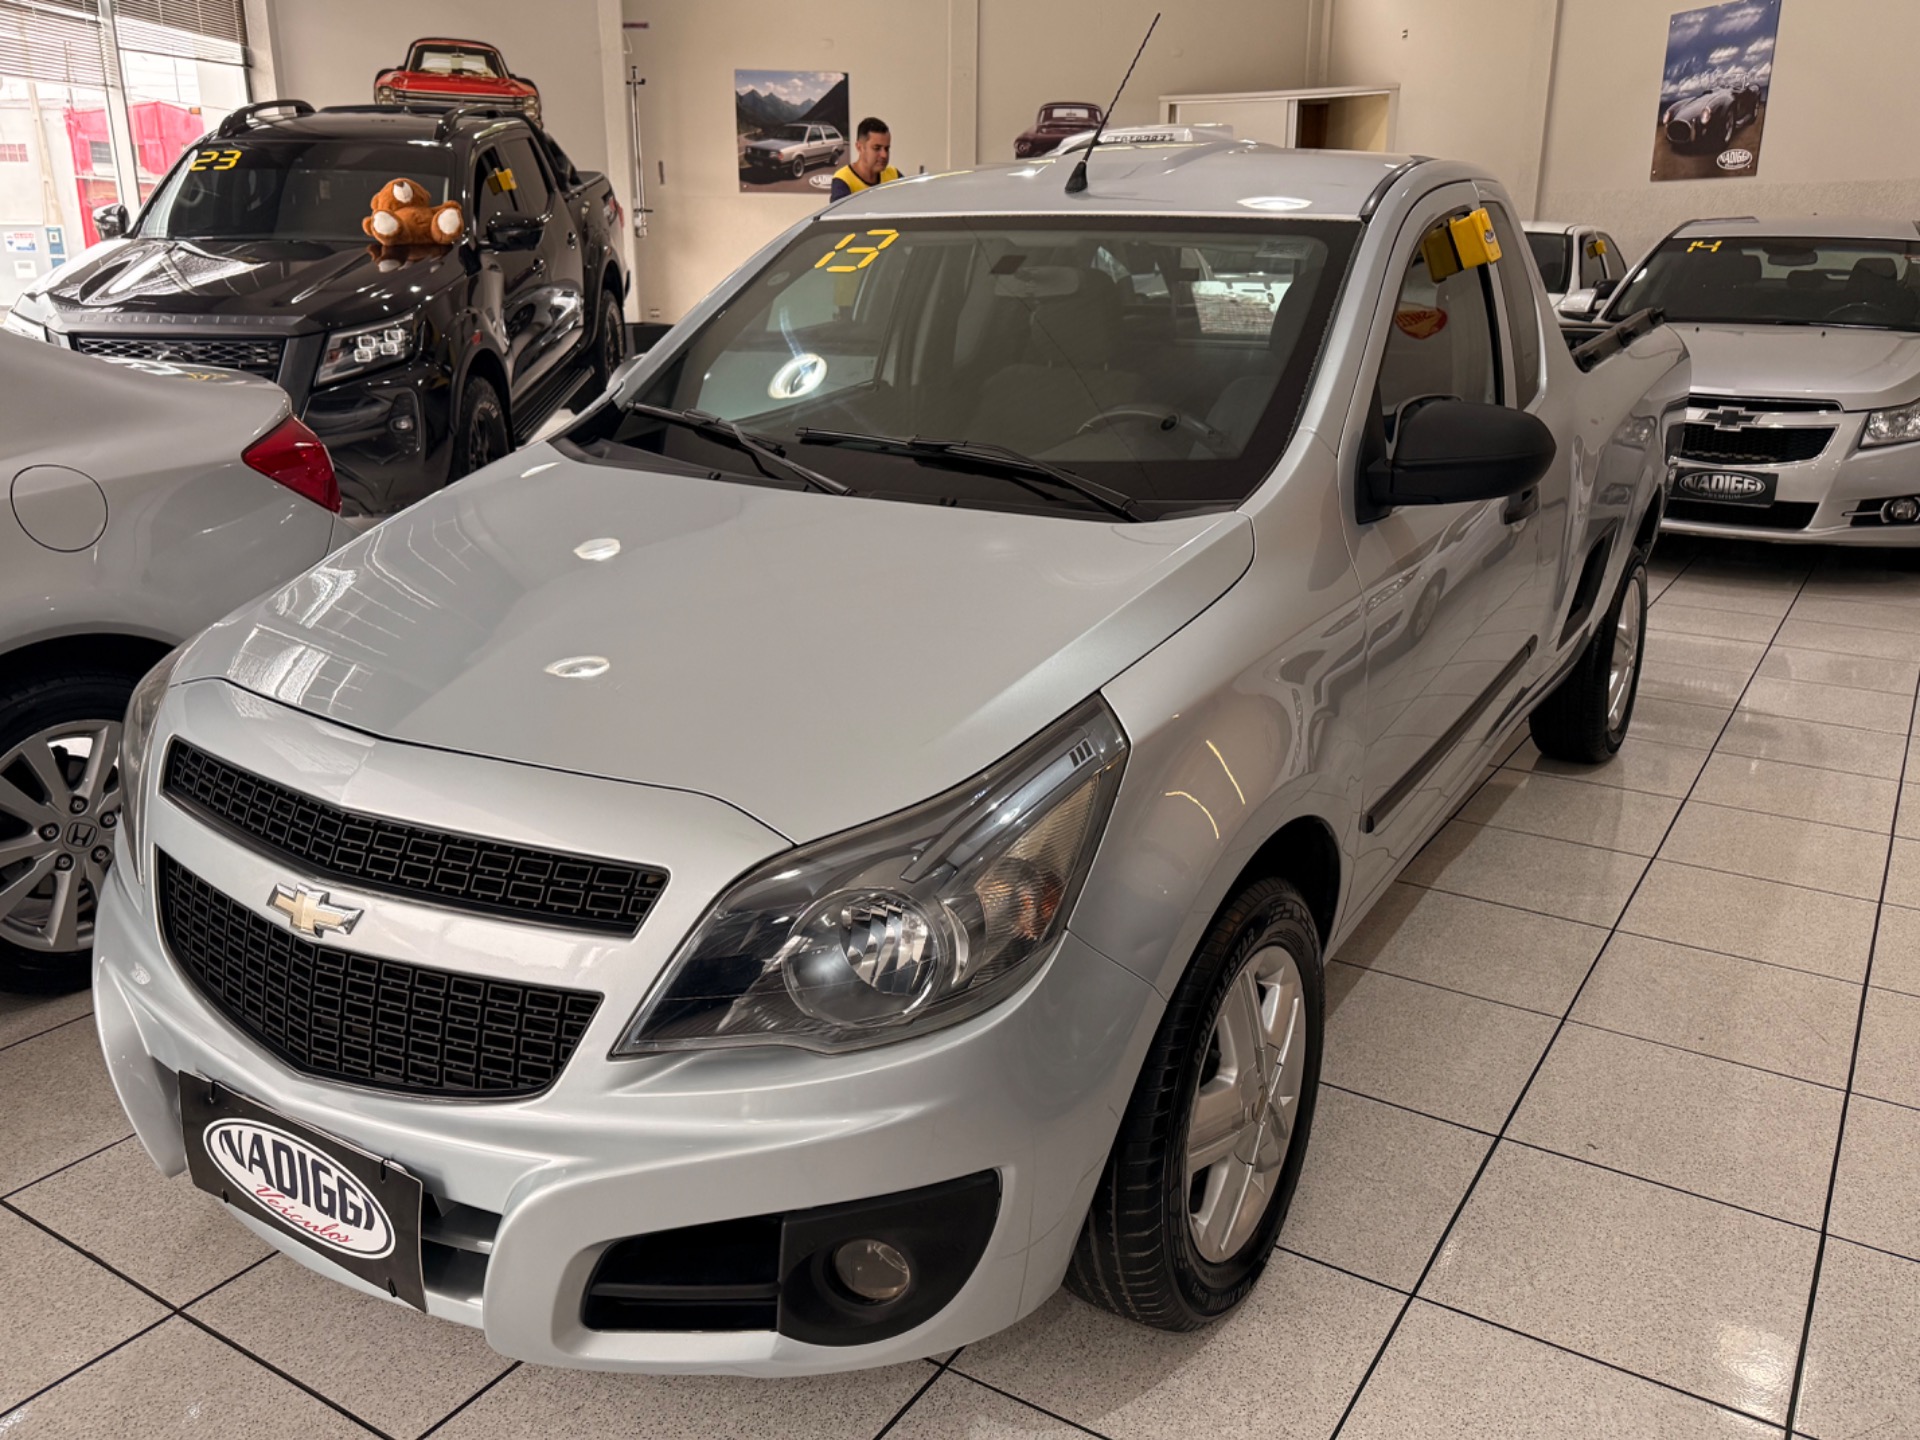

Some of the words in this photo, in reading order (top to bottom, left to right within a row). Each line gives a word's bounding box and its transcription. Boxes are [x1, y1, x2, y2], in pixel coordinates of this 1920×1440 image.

[190, 150, 242, 171] 23
[814, 229, 899, 272] 13
[1687, 240, 1722, 253] 14
[1684, 474, 1762, 493] NADIGGI
[218, 1130, 376, 1231] NADIGGI
